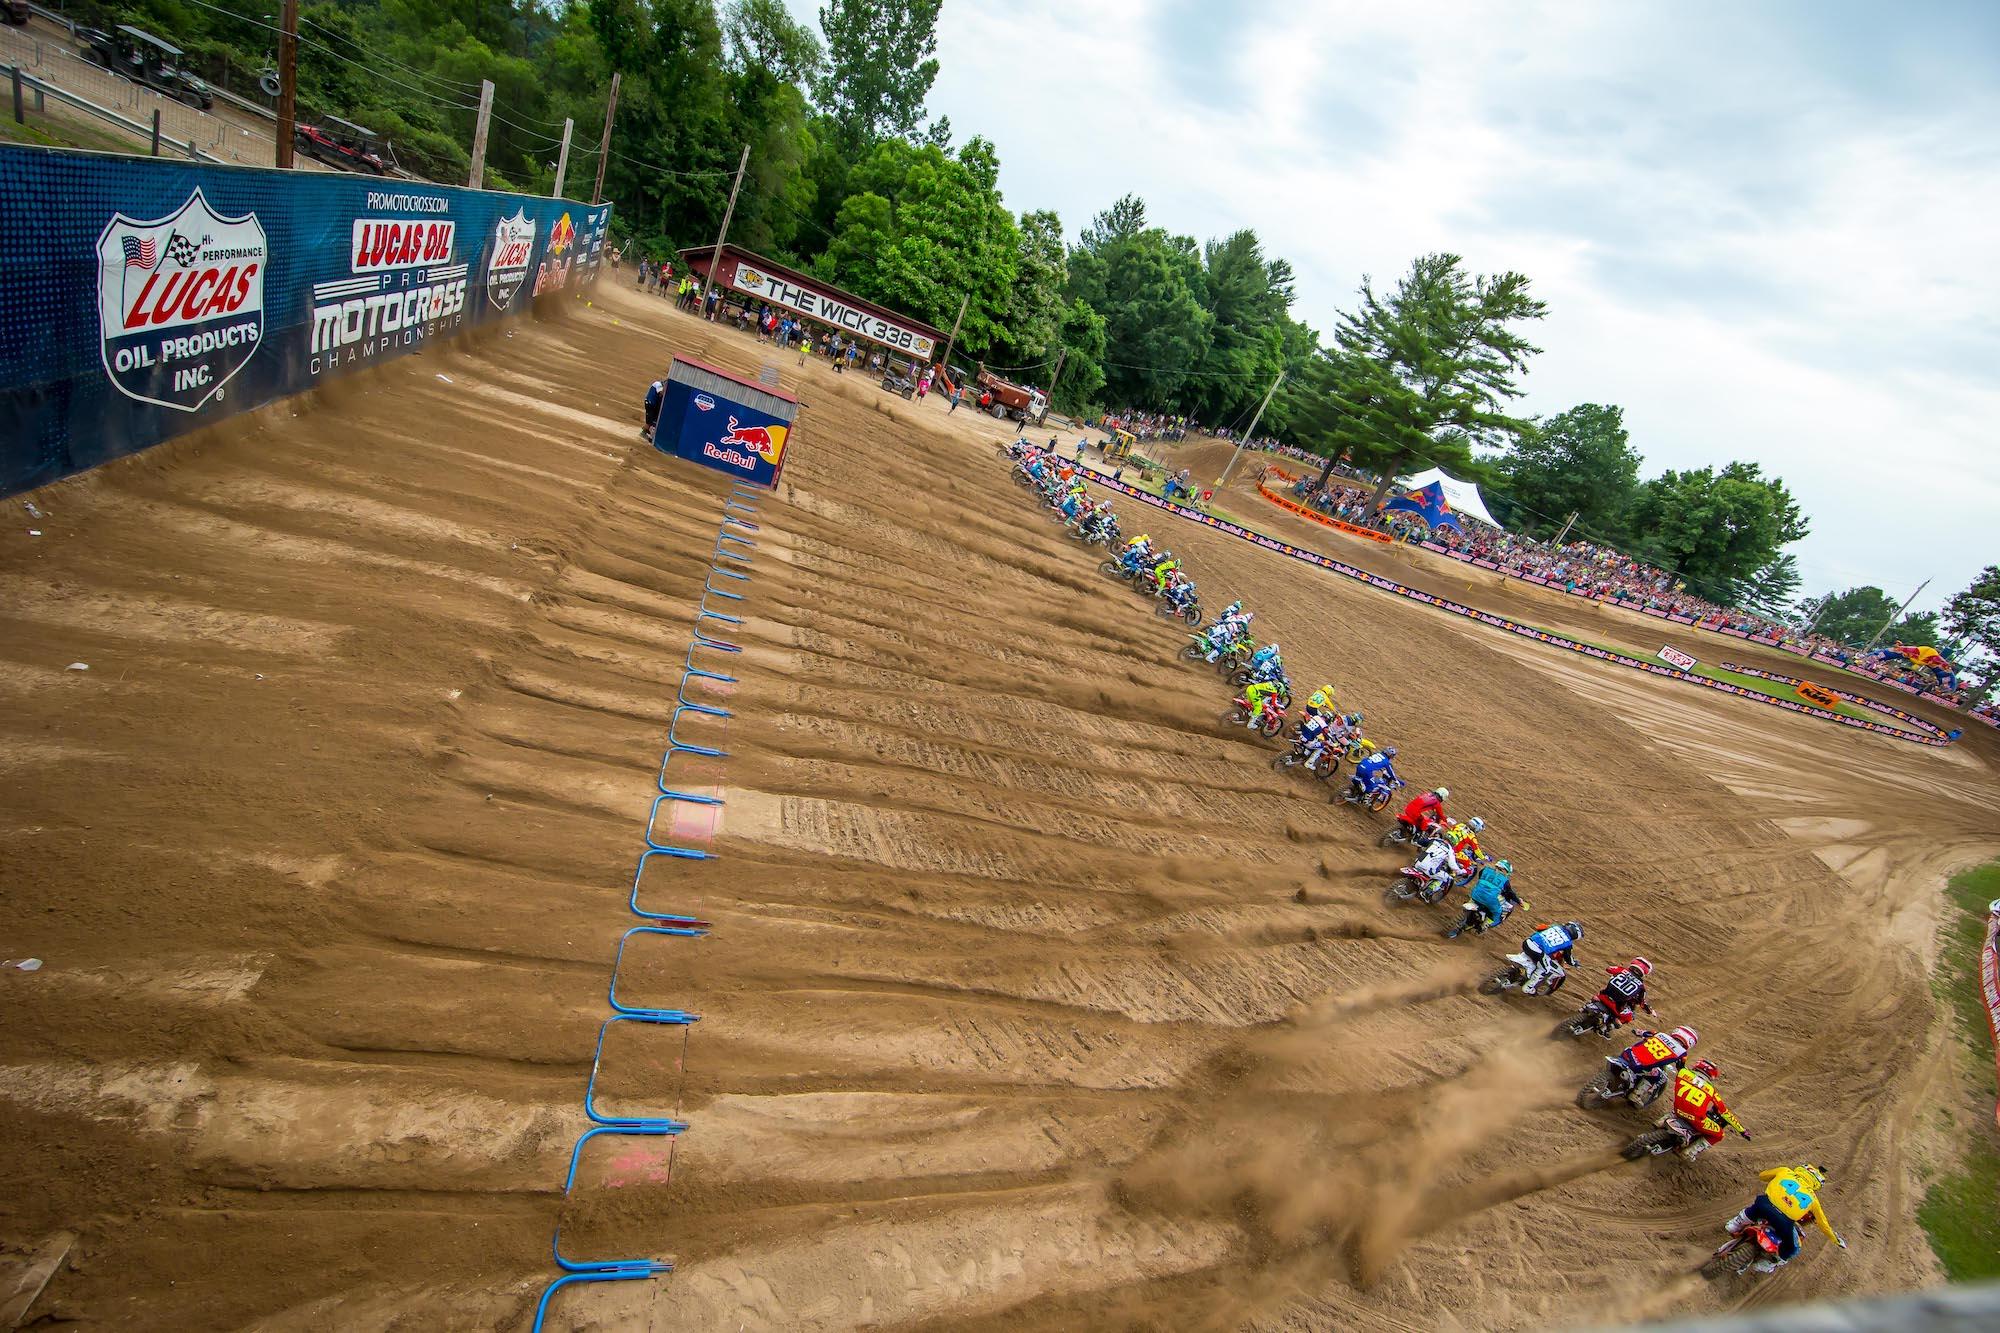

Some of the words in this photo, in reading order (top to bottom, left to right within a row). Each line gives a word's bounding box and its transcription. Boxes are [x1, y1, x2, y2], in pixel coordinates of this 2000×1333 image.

[202, 235, 214, 246] HI-
[356, 223, 424, 267] LUCAS
[423, 223, 452, 262] OIL
[202, 247, 263, 262] PERFORMANCE
[495, 242, 531, 267] LUCAS
[382, 269, 425, 289] PRO
[489, 275, 498, 286] OIL
[499, 271, 525, 283] PRODUCTS
[123, 263, 258, 330] LUCAS
[311, 279, 467, 354] MOTOCROSS
[766, 277, 818, 313] THE
[821, 298, 873, 334] WICK
[873, 321, 913, 349] 338
[115, 345, 155, 373] OIL
[161, 321, 259, 363] PRODUCTS
[310, 315, 462, 376] CHAMPIONSHIP
[174, 364, 213, 392] INC.
[1800, 687, 1832, 705] KTM
[1610, 973, 1638, 996] 210
[1644, 1037, 1672, 1060] 583
[1677, 1080, 1707, 1107] 719
[1778, 1179, 1813, 1210] 44
